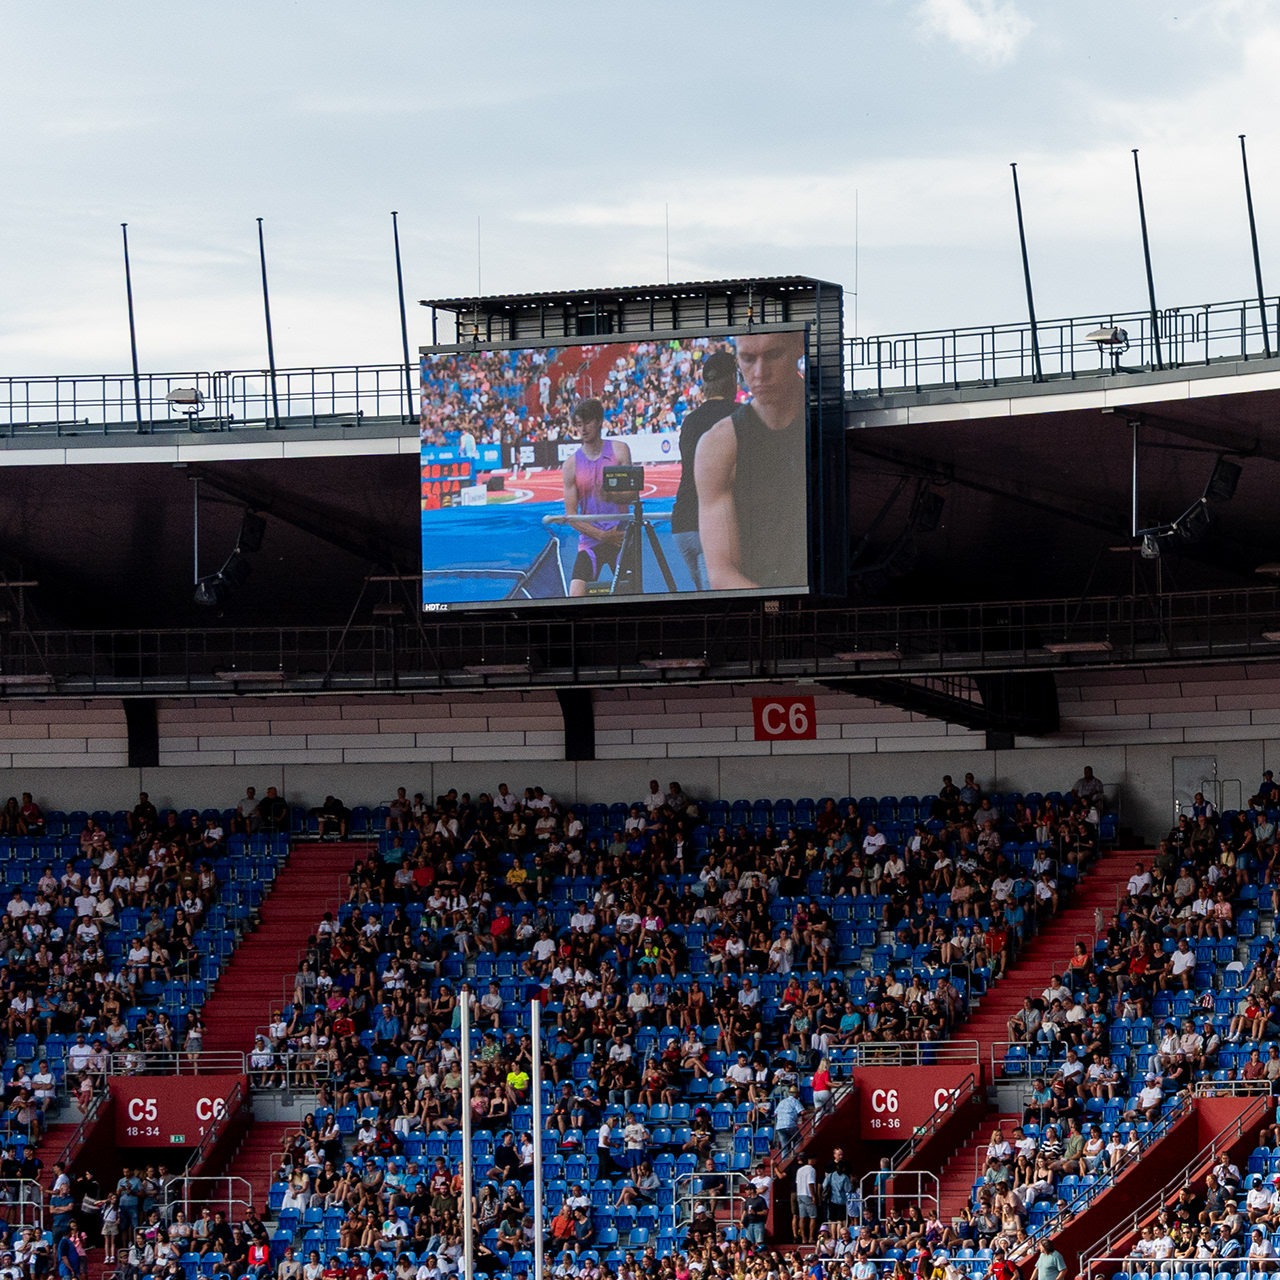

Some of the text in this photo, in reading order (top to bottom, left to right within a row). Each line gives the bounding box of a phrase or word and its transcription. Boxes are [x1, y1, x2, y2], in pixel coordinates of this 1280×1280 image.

[761, 703, 809, 735] C6
[128, 1097, 225, 1121] C5 C6
[872, 1089, 898, 1113] C6
[126, 1127, 138, 1136] 18
[146, 1127, 160, 1136] 34
[870, 1119, 881, 1128] 18
[888, 1119, 900, 1128] 36
